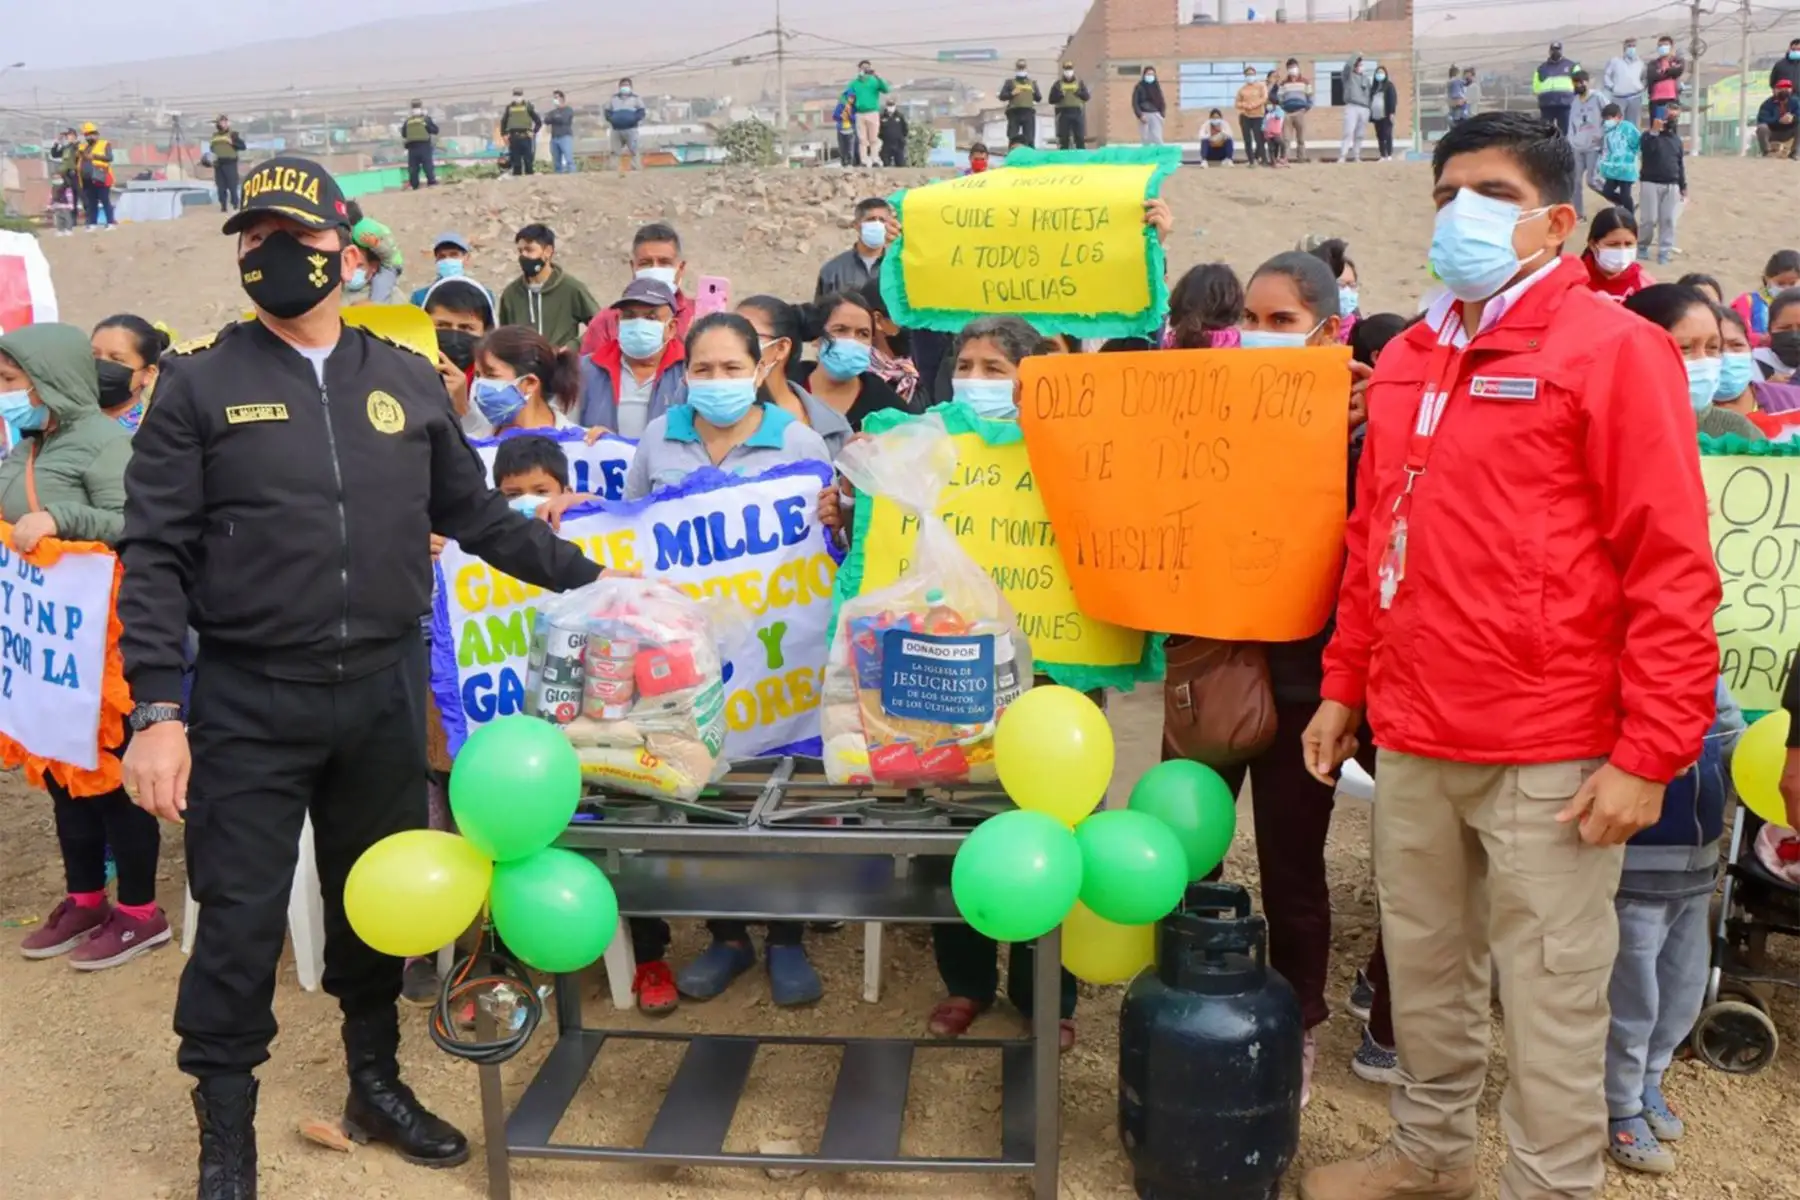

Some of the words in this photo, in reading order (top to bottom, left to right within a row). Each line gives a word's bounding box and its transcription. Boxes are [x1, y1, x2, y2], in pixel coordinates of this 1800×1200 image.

[243, 166, 318, 207] POLICIA
[941, 205, 995, 228] CUIDE
[1008, 207, 1020, 227] Y
[1032, 206, 1110, 232] PROTEJA
[951, 246, 963, 266] A
[974, 245, 1040, 268] TODOS
[1060, 242, 1104, 267] LOS
[574, 459, 628, 501] LE
[1015, 471, 1032, 492] A
[653, 495, 811, 571] MILLE
[1, 580, 14, 615] Y
[1, 625, 32, 674] POR
[42, 648, 80, 688] LA
[757, 621, 787, 670] Y
[906, 643, 950, 657] DONADO
[892, 671, 987, 692] JESUCRISTO
[912, 663, 923, 671] LA
[924, 665, 958, 676] IGLESIA
[960, 667, 972, 676] DE
[940, 694, 974, 703] SANTOS
